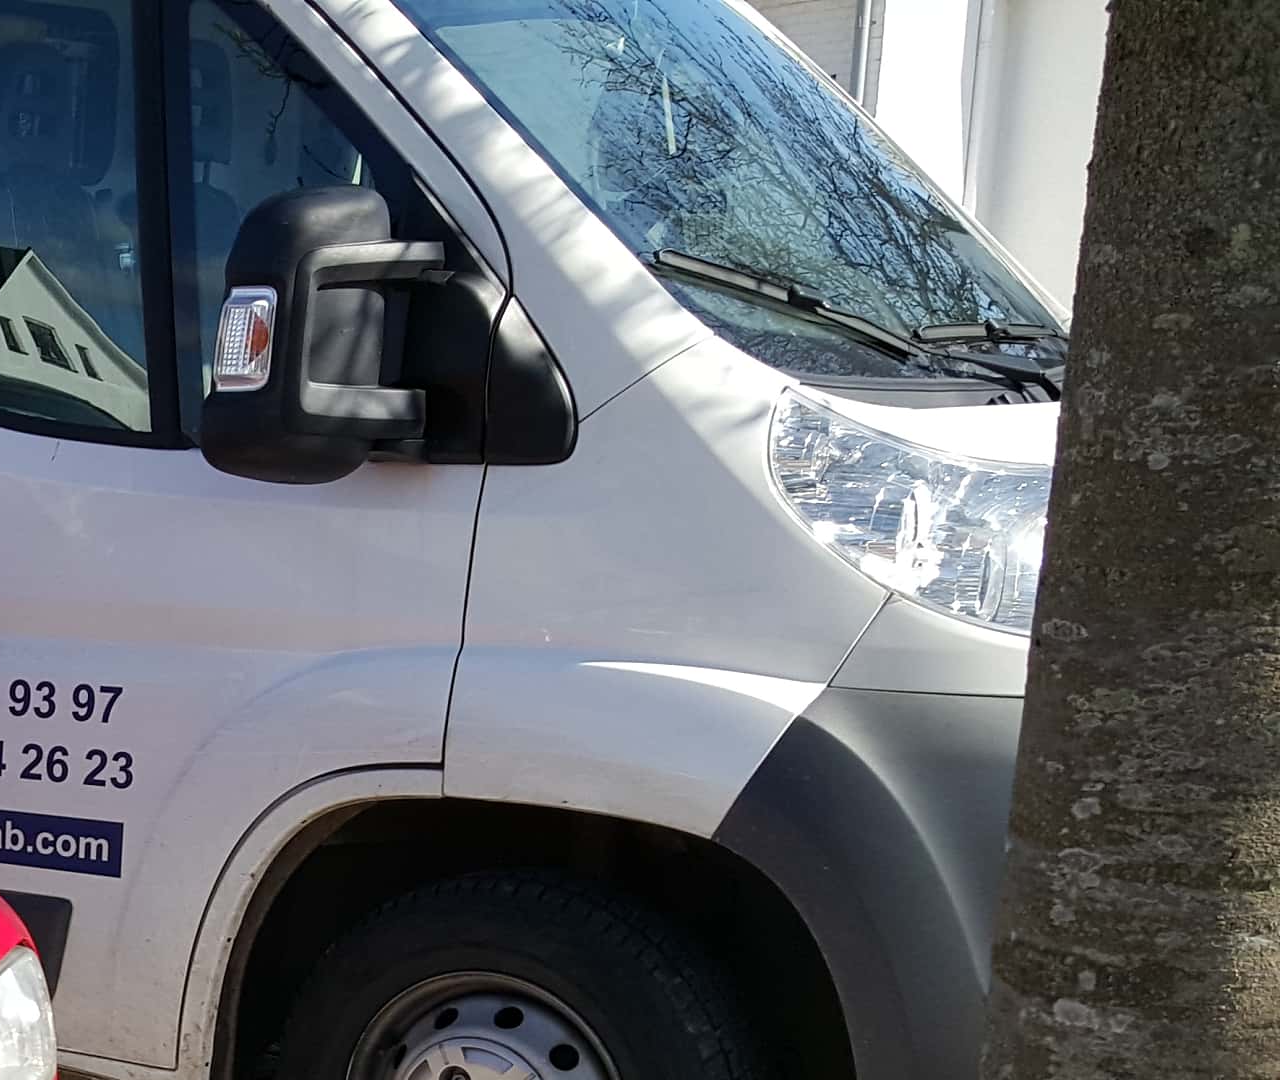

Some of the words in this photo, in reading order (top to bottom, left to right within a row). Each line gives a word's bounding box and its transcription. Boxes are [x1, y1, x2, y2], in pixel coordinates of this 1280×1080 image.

[8, 679, 56, 719] 93
[72, 684, 123, 723] 97
[20, 743, 69, 782] 26
[83, 749, 133, 788] 23
